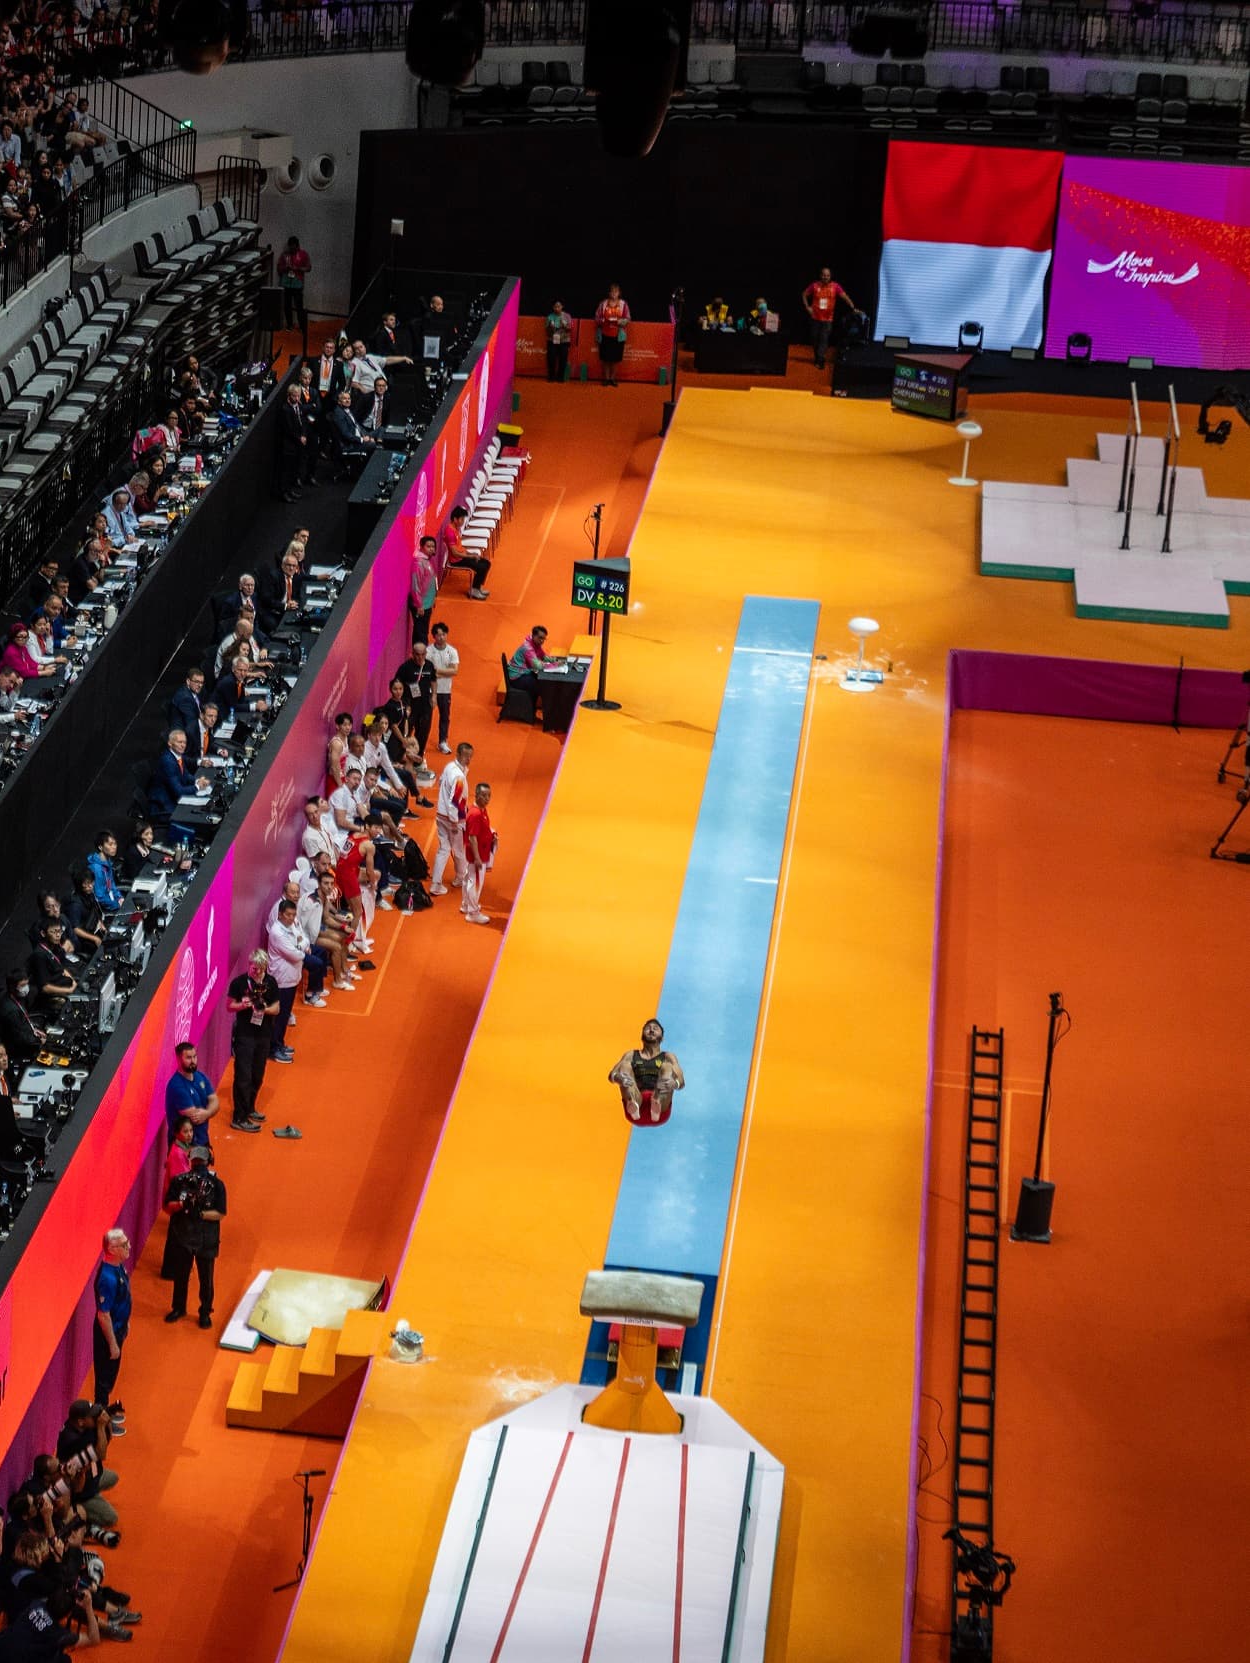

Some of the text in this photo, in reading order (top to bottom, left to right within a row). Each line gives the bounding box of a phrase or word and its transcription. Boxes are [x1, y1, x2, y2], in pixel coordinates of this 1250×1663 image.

[1124, 266, 1184, 288] Inspire
[577, 576, 593, 587] GO
[609, 581, 625, 593] 226
[577, 588, 624, 609] DV 5.20
